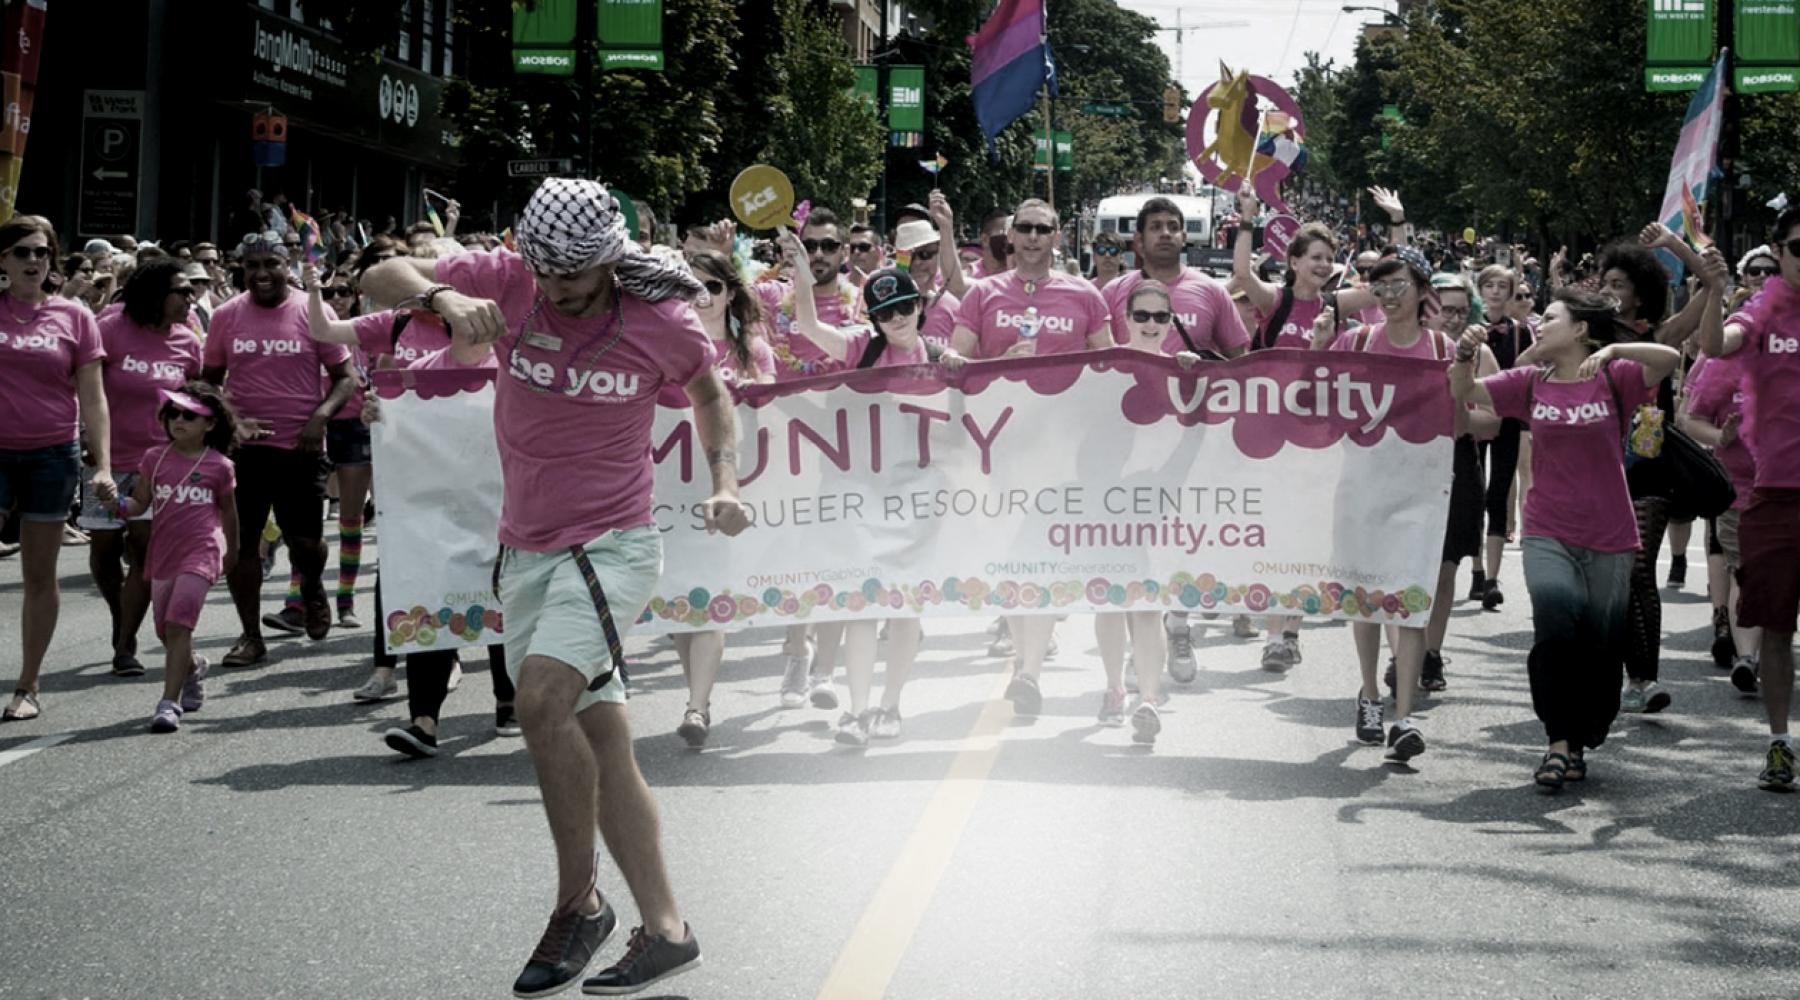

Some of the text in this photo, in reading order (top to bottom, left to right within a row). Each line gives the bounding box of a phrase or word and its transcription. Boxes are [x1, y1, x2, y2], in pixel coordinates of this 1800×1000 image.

[103, 128, 125, 154] P
[996, 309, 1023, 328] be
[11, 334, 58, 351] you
[232, 337, 301, 356] be you
[393, 343, 417, 361] be
[1768, 333, 1798, 353] be
[121, 354, 149, 374] be
[509, 349, 640, 397] be you
[1167, 366, 1395, 433] vancity
[1532, 402, 1561, 421] be
[1566, 401, 1609, 424] you
[174, 484, 213, 504] you
[883, 488, 1083, 521] RESOURCE
[1104, 487, 1263, 516] CENTRE
[1047, 516, 1266, 555] qmunity.ca
[985, 561, 1137, 575] QMUNITYGenerations
